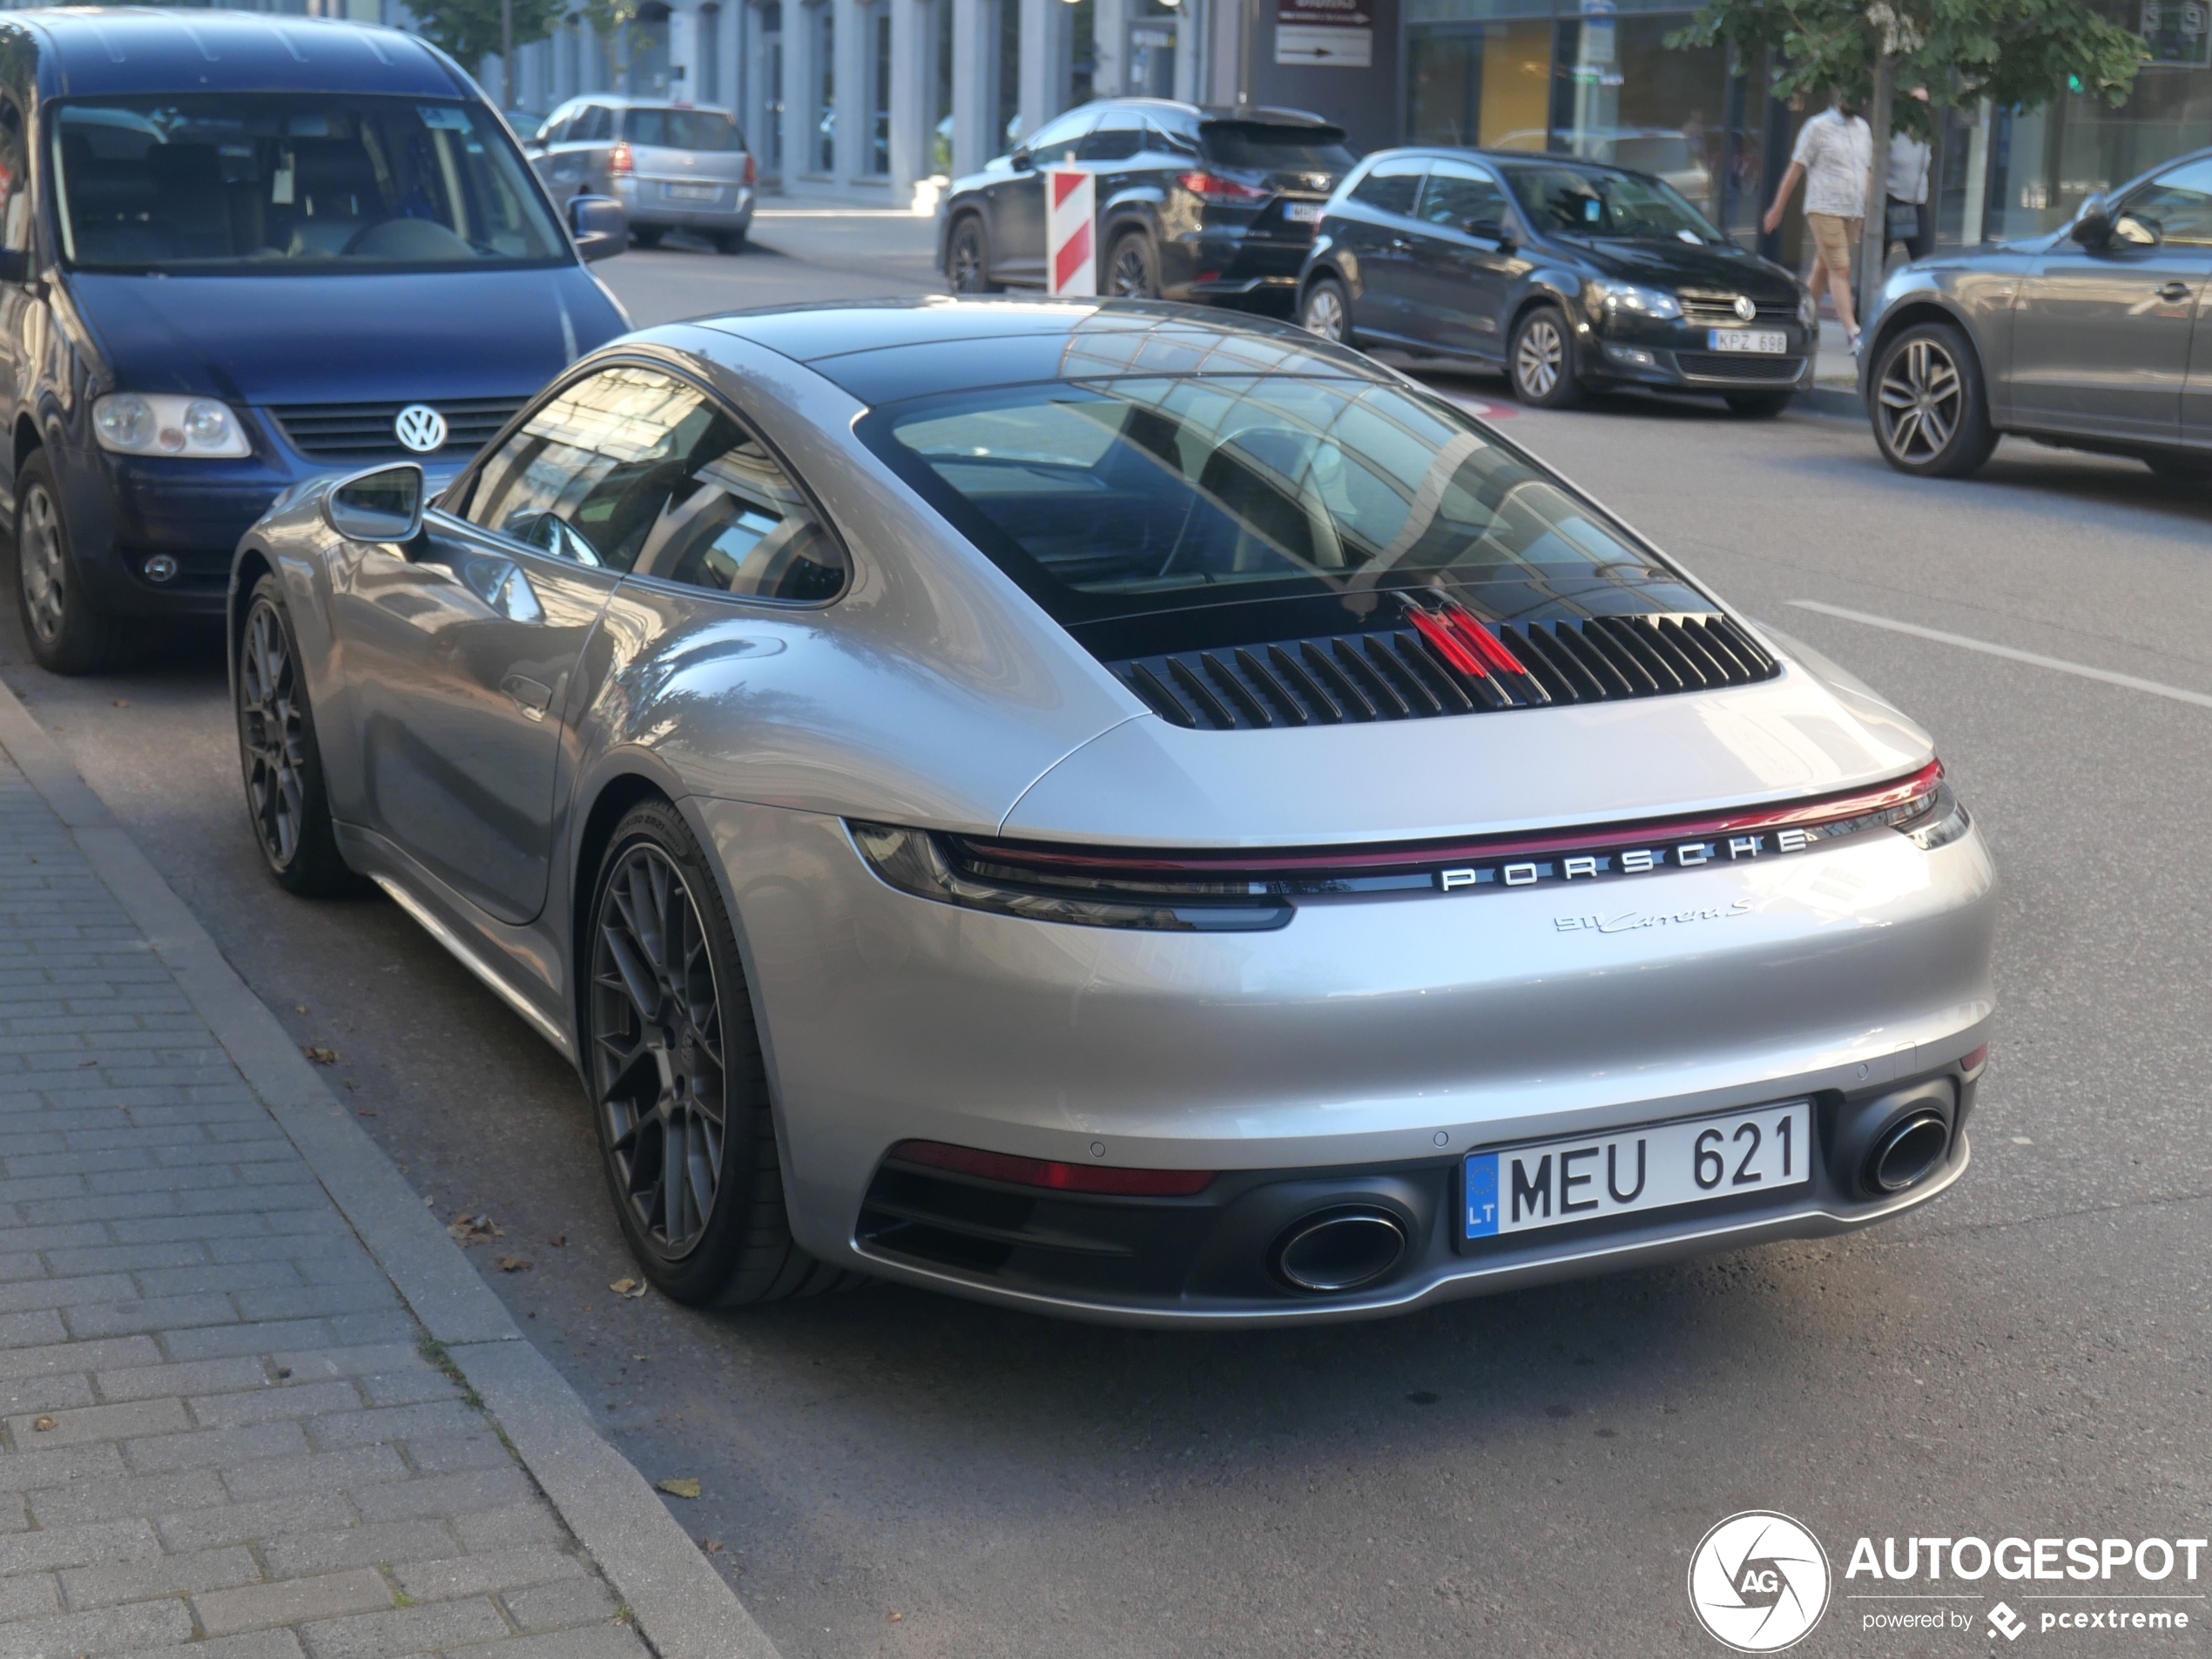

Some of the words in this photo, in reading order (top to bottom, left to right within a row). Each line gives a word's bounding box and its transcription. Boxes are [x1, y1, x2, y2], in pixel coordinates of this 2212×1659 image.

[1718, 334, 1750, 350] KPZ
[1440, 828, 1807, 892] PORSCHE
[1554, 912, 1604, 932] 911
[1599, 907, 1721, 933] Carrera
[1725, 897, 1755, 917] S
[1512, 1139, 1646, 1223] MEU
[1694, 1115, 1792, 1190] 621
[1469, 1204, 1495, 1224] LT
